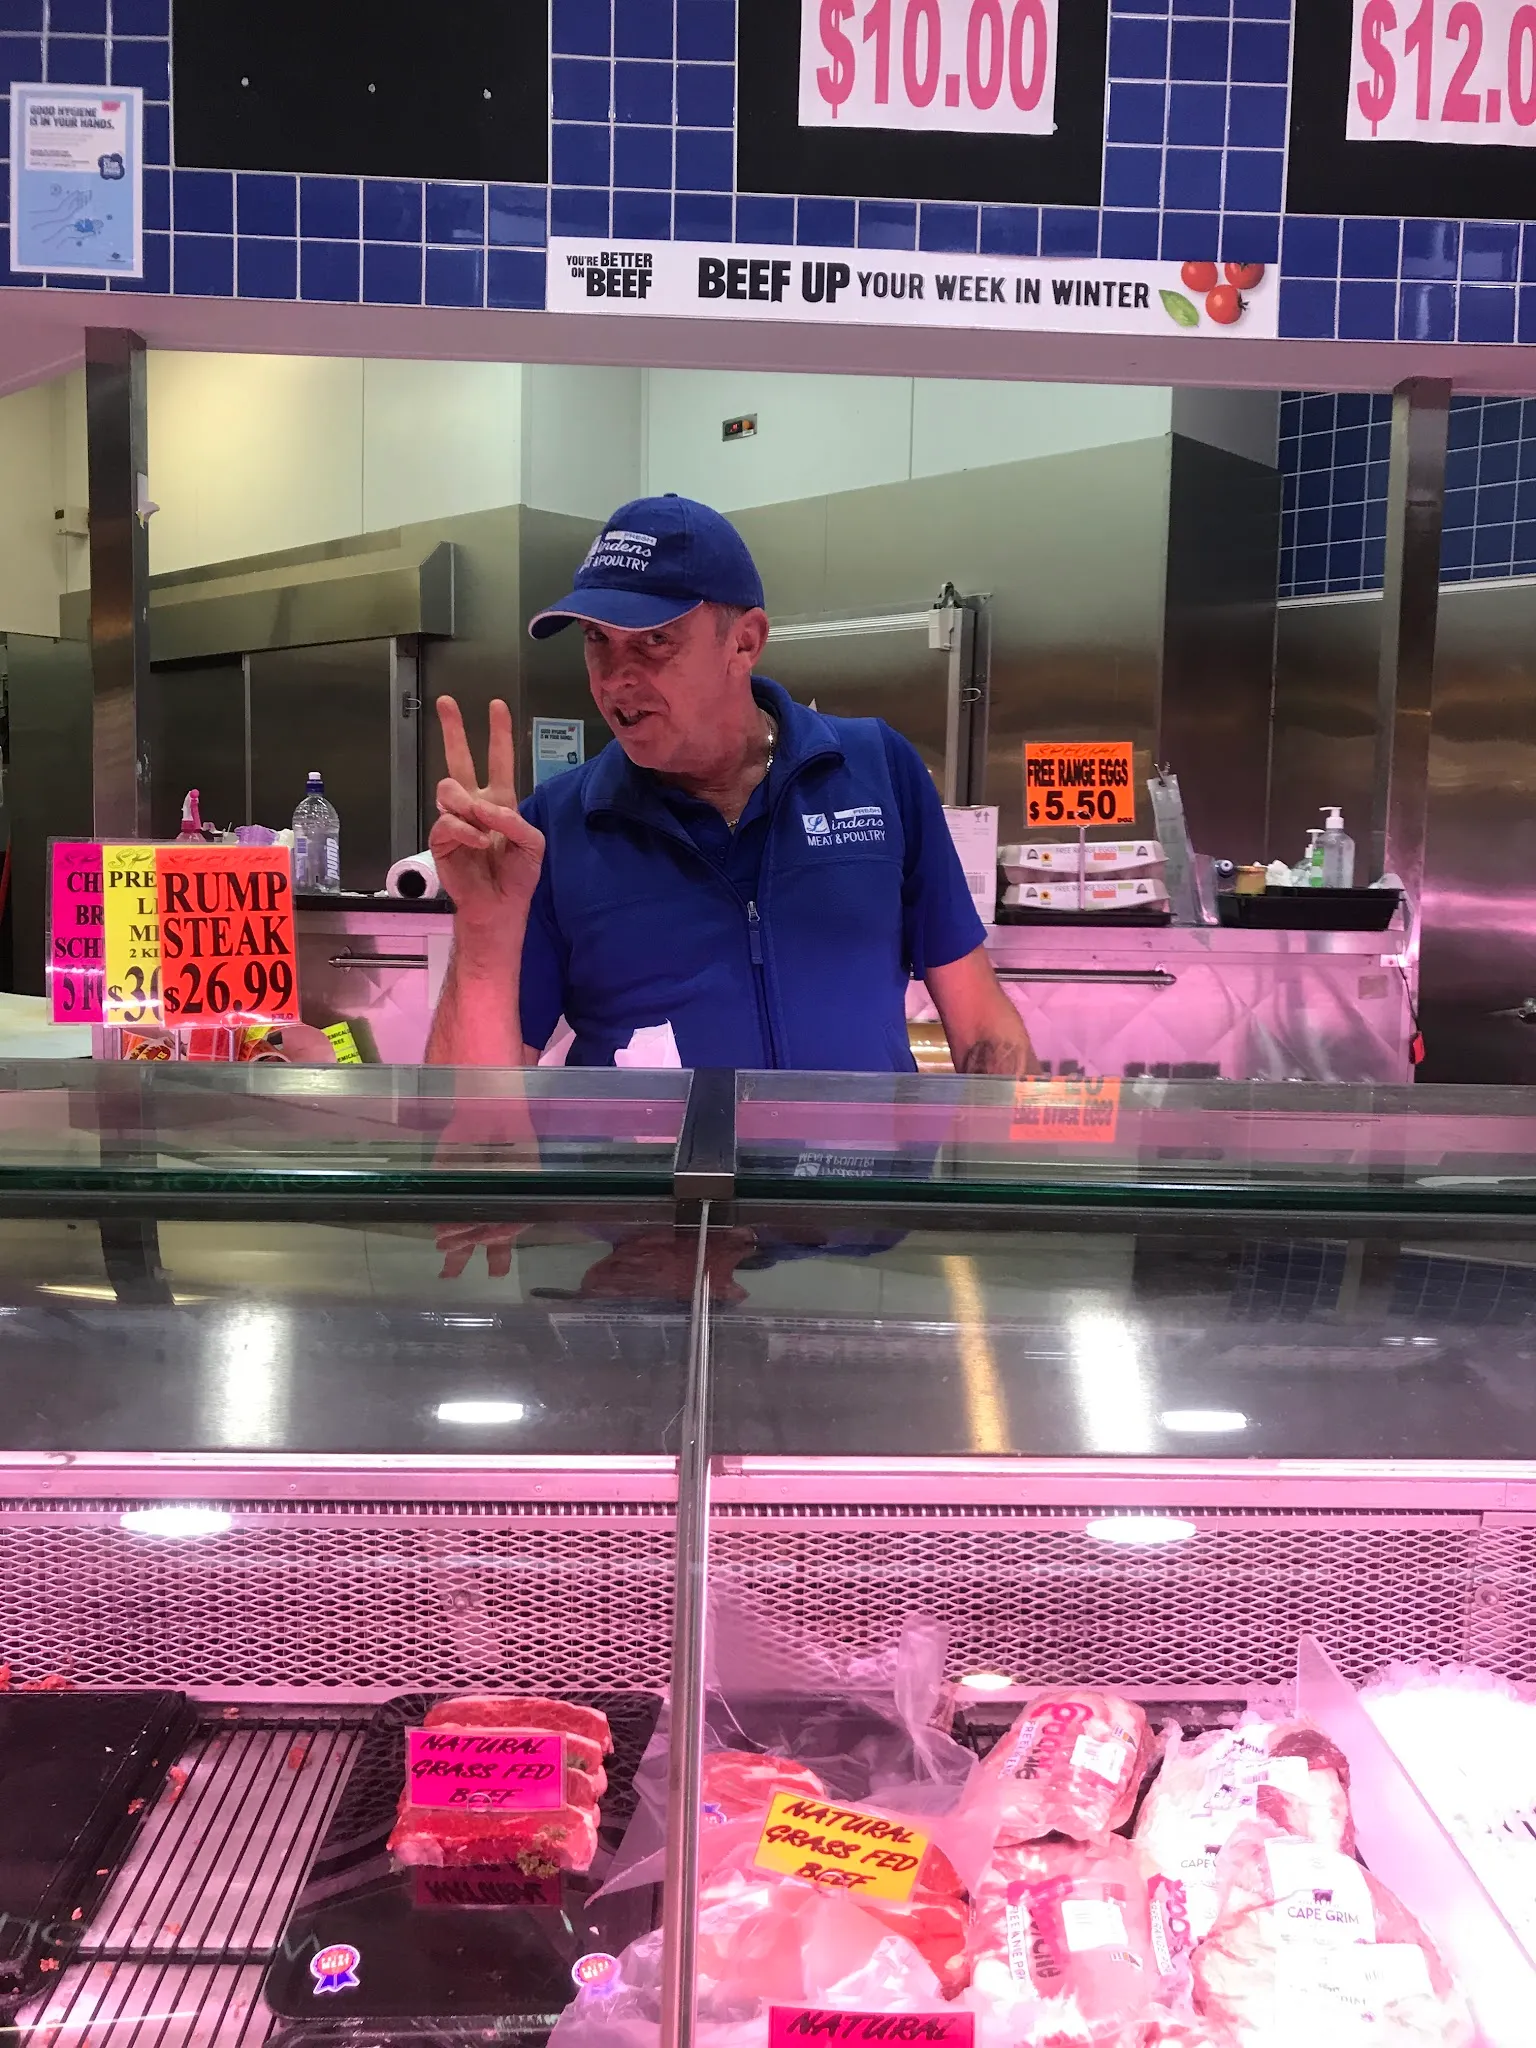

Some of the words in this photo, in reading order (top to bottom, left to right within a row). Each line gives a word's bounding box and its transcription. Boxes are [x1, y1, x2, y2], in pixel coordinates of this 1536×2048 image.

[816, 0, 1047, 119] $10.00
[566, 255, 598, 266] YOU'RE
[600, 252, 653, 268] BETTER
[571, 267, 585, 278] ON
[586, 268, 653, 299] BEEF
[698, 257, 791, 303] BEEF
[802, 261, 850, 303] UP
[857, 271, 924, 299] YOUR
[935, 274, 1005, 302] WEEK
[1016, 278, 1040, 304] IN
[1052, 279, 1150, 308] WINTER
[598, 555, 649, 572] POULTRY
[1027, 758, 1055, 787] FREE
[1058, 758, 1096, 787] RANGE
[1099, 758, 1128, 787] EGGS
[807, 835, 833, 846] MEAT
[835, 834, 843, 844] &
[843, 830, 886, 844] POULTRY
[326, 837, 340, 881] pump
[67, 871, 104, 893] CH
[162, 871, 288, 913] RUMP
[54, 936, 105, 959] SCH
[164, 915, 291, 959] STEAK
[130, 948, 137, 958] 2
[164, 960, 293, 1014] $26.99
[419, 1734, 546, 1755] NATURAL
[411, 1759, 498, 1780] GRASS
[502, 1763, 556, 1781] FED
[447, 1787, 525, 1804] BEEF
[782, 1800, 915, 1844] NATURAL
[766, 1824, 861, 1859] GRASS
[860, 1849, 919, 1872] FED
[794, 1862, 877, 1888] BEEF
[1181, 1858, 1211, 1870] CAPE
[1287, 1906, 1322, 1921] CAPE
[1325, 1909, 1360, 1925] GRIM
[786, 2011, 956, 2041] NATURAL
